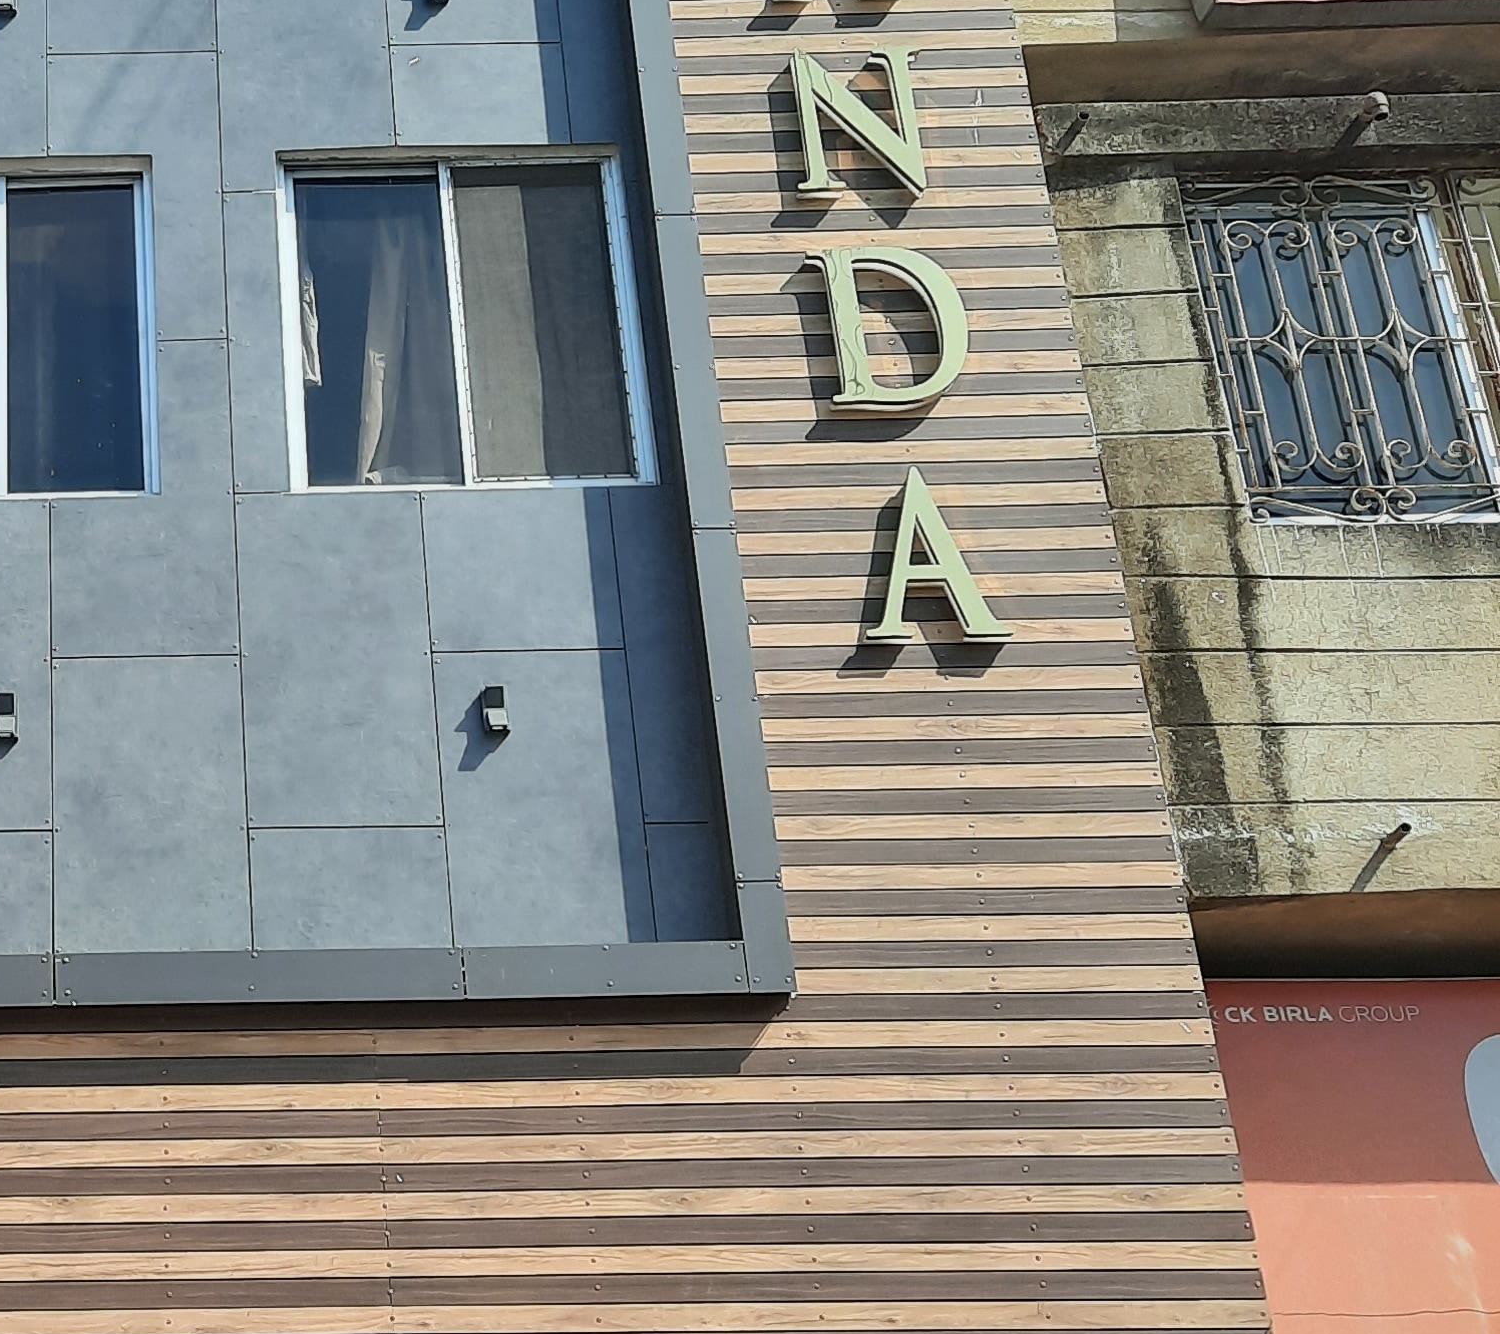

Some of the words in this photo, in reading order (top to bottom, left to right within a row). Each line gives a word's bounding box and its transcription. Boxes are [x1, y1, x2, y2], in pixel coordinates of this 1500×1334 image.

[1224, 1006, 1258, 1023] CK
[1263, 1006, 1333, 1023] BIRLA
[1338, 1005, 1421, 1023] GROUP
